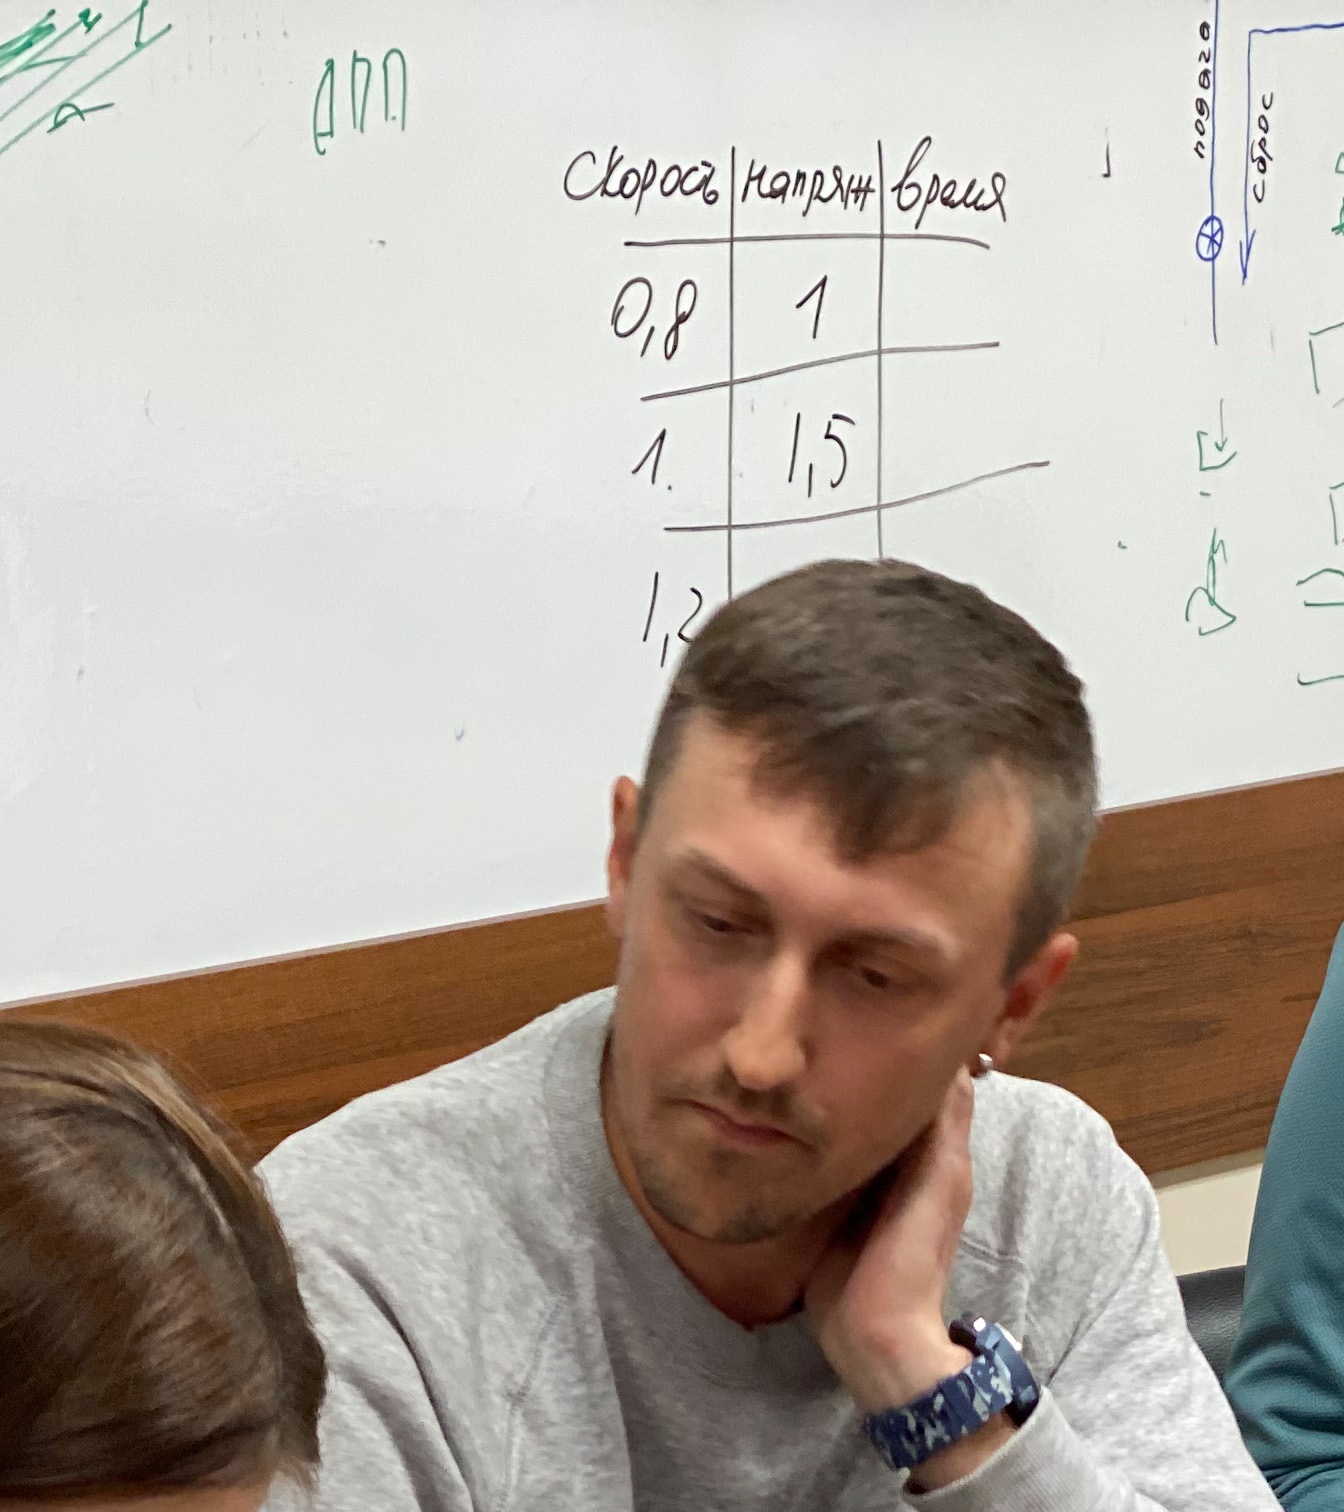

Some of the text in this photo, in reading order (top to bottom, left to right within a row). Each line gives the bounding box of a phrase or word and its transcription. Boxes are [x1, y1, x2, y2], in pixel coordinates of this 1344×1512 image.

[610, 274, 828, 360] 0,8 1
[787, 411, 856, 498] 1,5
[641, 570, 704, 668] 1,2
